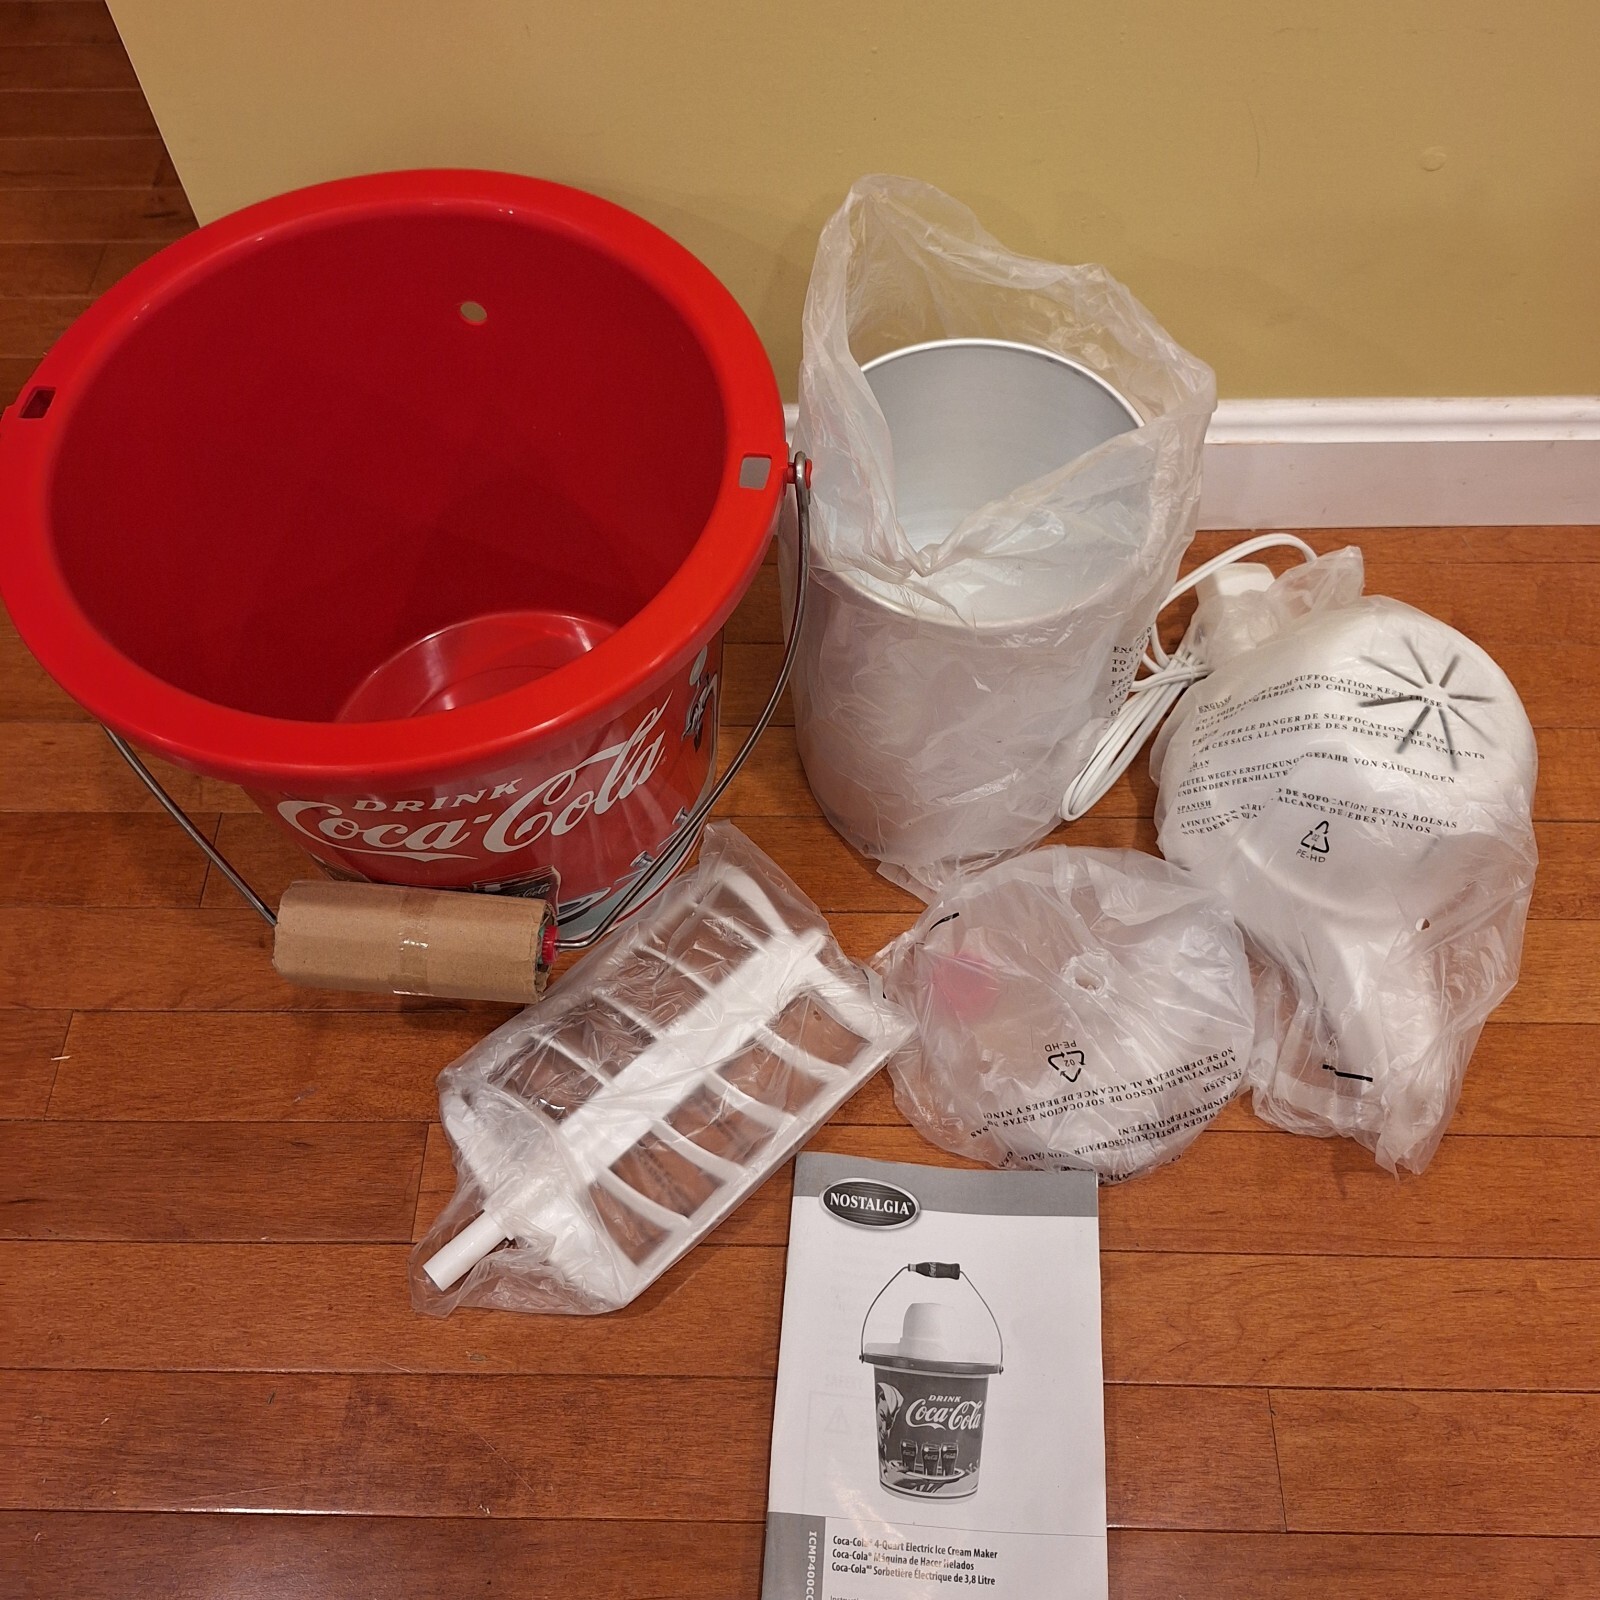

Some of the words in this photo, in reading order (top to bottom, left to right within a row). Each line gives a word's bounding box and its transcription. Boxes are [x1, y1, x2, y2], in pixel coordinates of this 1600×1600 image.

[1294, 674, 1373, 690] SUFFOCATION
[1298, 681, 1321, 691] AND
[1325, 683, 1385, 701] CHILDREN
[1230, 734, 1254, 745] SACS
[1325, 722, 1348, 731] DES
[1409, 738, 1432, 749] DES
[1259, 715, 1302, 729] DANGER
[1304, 712, 1319, 721] DE
[1323, 713, 1404, 733] SUFFOCATION
[1426, 733, 1446, 745] PAS
[278, 689, 674, 862] Coca-Cola
[1207, 768, 1238, 781] WEGEN
[1354, 757, 1378, 769] VON
[352, 777, 523, 813] DRINK
[1193, 780, 1230, 794] KINDERN
[1177, 800, 1212, 815] SPANISH
[1277, 795, 1326, 813] ALCANCE
[1285, 788, 1299, 797] DE
[1371, 806, 1408, 820] ESTAS
[1412, 813, 1458, 829] BOLSAS
[1044, 1040, 1077, 1053] PE-HD
[1061, 1095, 1075, 1104] DE
[1076, 1084, 1127, 1100] ALCANCE
[1109, 1096, 1123, 1104] DE
[1016, 1106, 1024, 1114] Y
[1025, 1098, 1060, 1111] BEBES
[1039, 1098, 1105, 1119] SOFOCACION
[1003, 1114, 1036, 1127] ESTAS
[928, 1394, 962, 1403] DRINK
[905, 1398, 984, 1431] Coca-Cola
[906, 1542, 934, 1554] Electric
[935, 1545, 946, 1555] Ice
[947, 1546, 972, 1557] Cream
[973, 1548, 998, 1559] Maker
[909, 1556, 919, 1566] de
[920, 1557, 942, 1568] Hacer
[953, 1573, 963, 1583] de
[964, 1574, 977, 1585] 3,8
[977, 1575, 996, 1586] Litre
